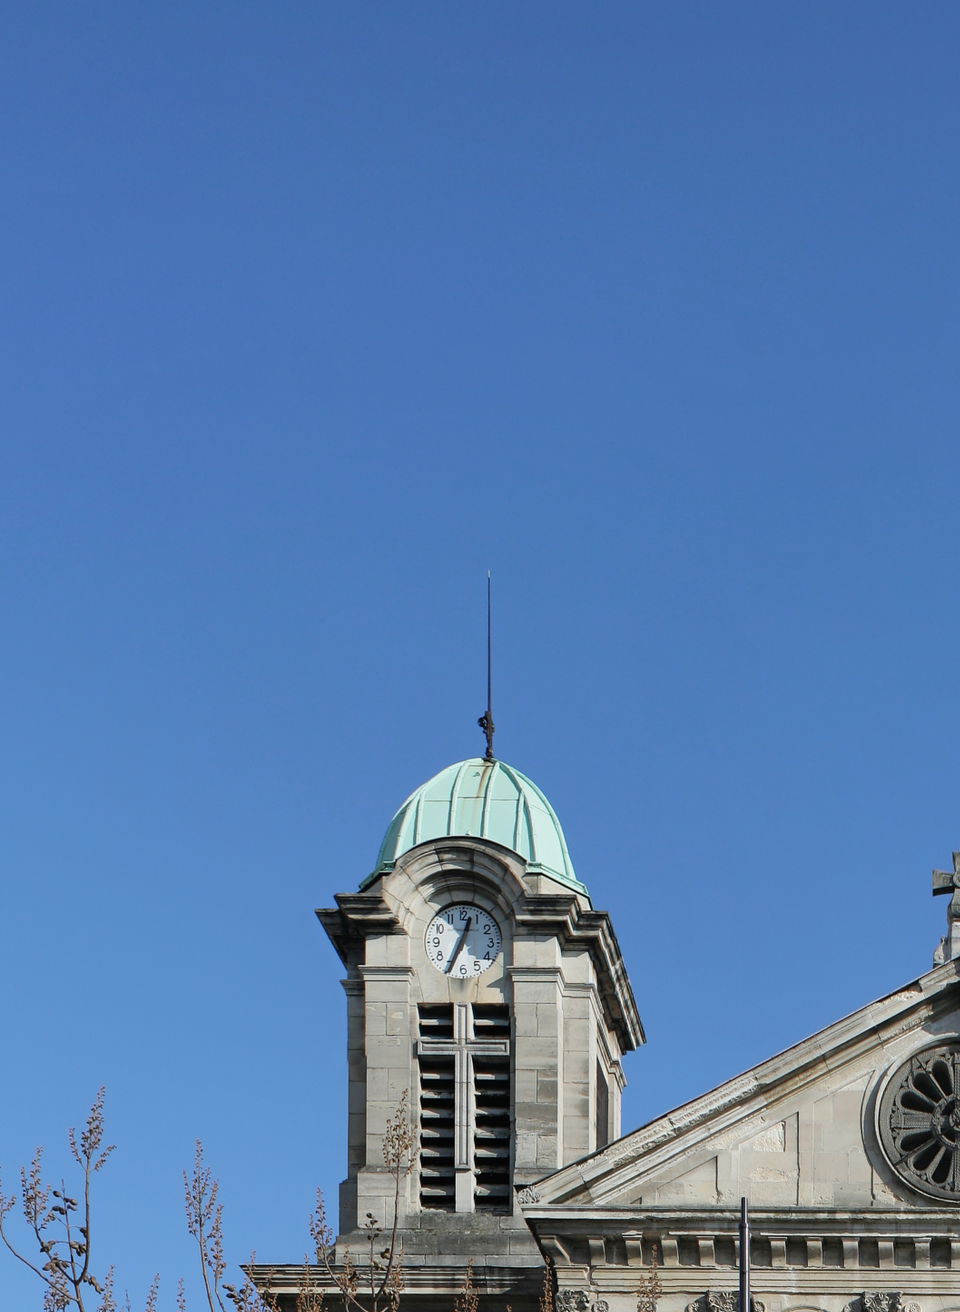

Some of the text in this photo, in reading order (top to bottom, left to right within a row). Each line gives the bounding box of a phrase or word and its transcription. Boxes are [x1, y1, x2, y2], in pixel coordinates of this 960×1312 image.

[447, 914, 454, 925] 11
[460, 910, 468, 921] 12
[475, 914, 479, 924] 1
[436, 923, 444, 934] 10
[483, 924, 491, 935] 2
[432, 937, 440, 948] 9
[487, 938, 495, 949] 3
[436, 951, 444, 961] 8
[483, 951, 491, 961] 4
[460, 965, 468, 975] 6
[473, 961, 481, 972] 5
